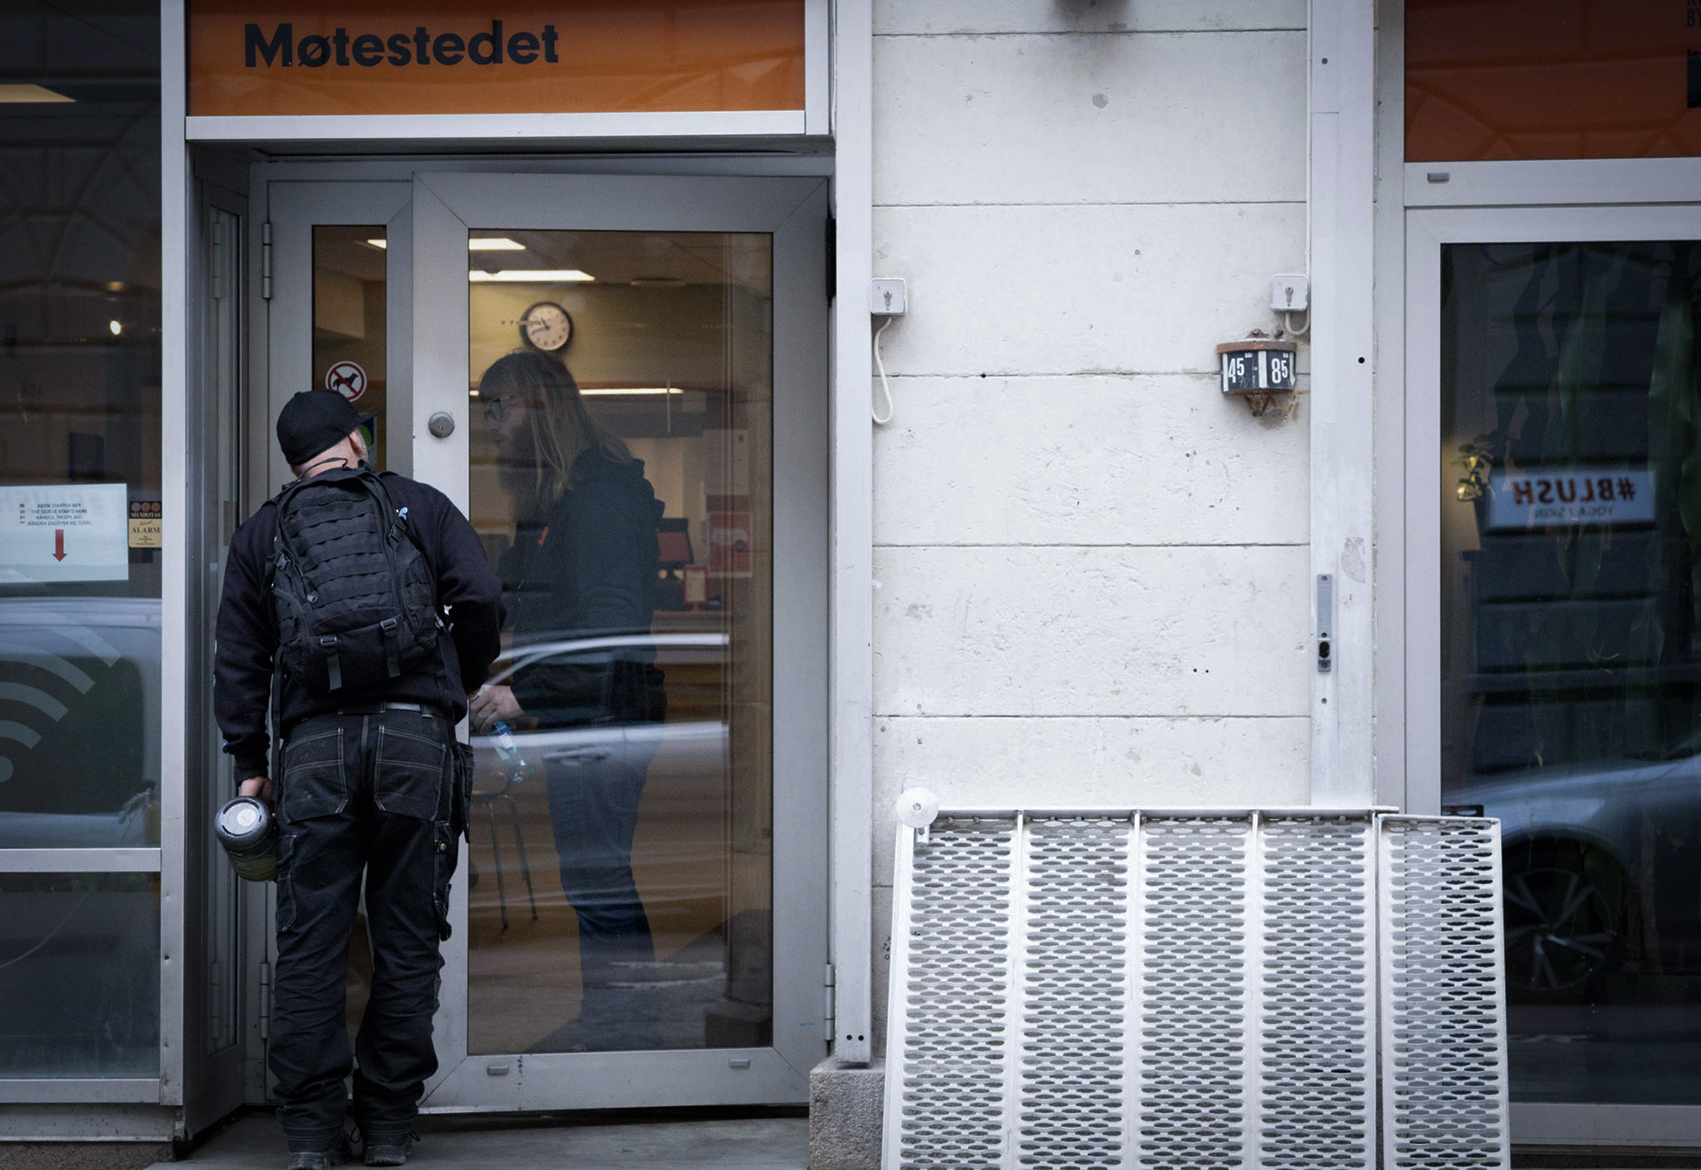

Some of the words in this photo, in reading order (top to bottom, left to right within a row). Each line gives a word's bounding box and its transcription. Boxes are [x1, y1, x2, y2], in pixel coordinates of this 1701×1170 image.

[244, 20, 559, 68] Møtestedet
[1228, 357, 1245, 383] 45
[1271, 358, 1289, 383] 85
